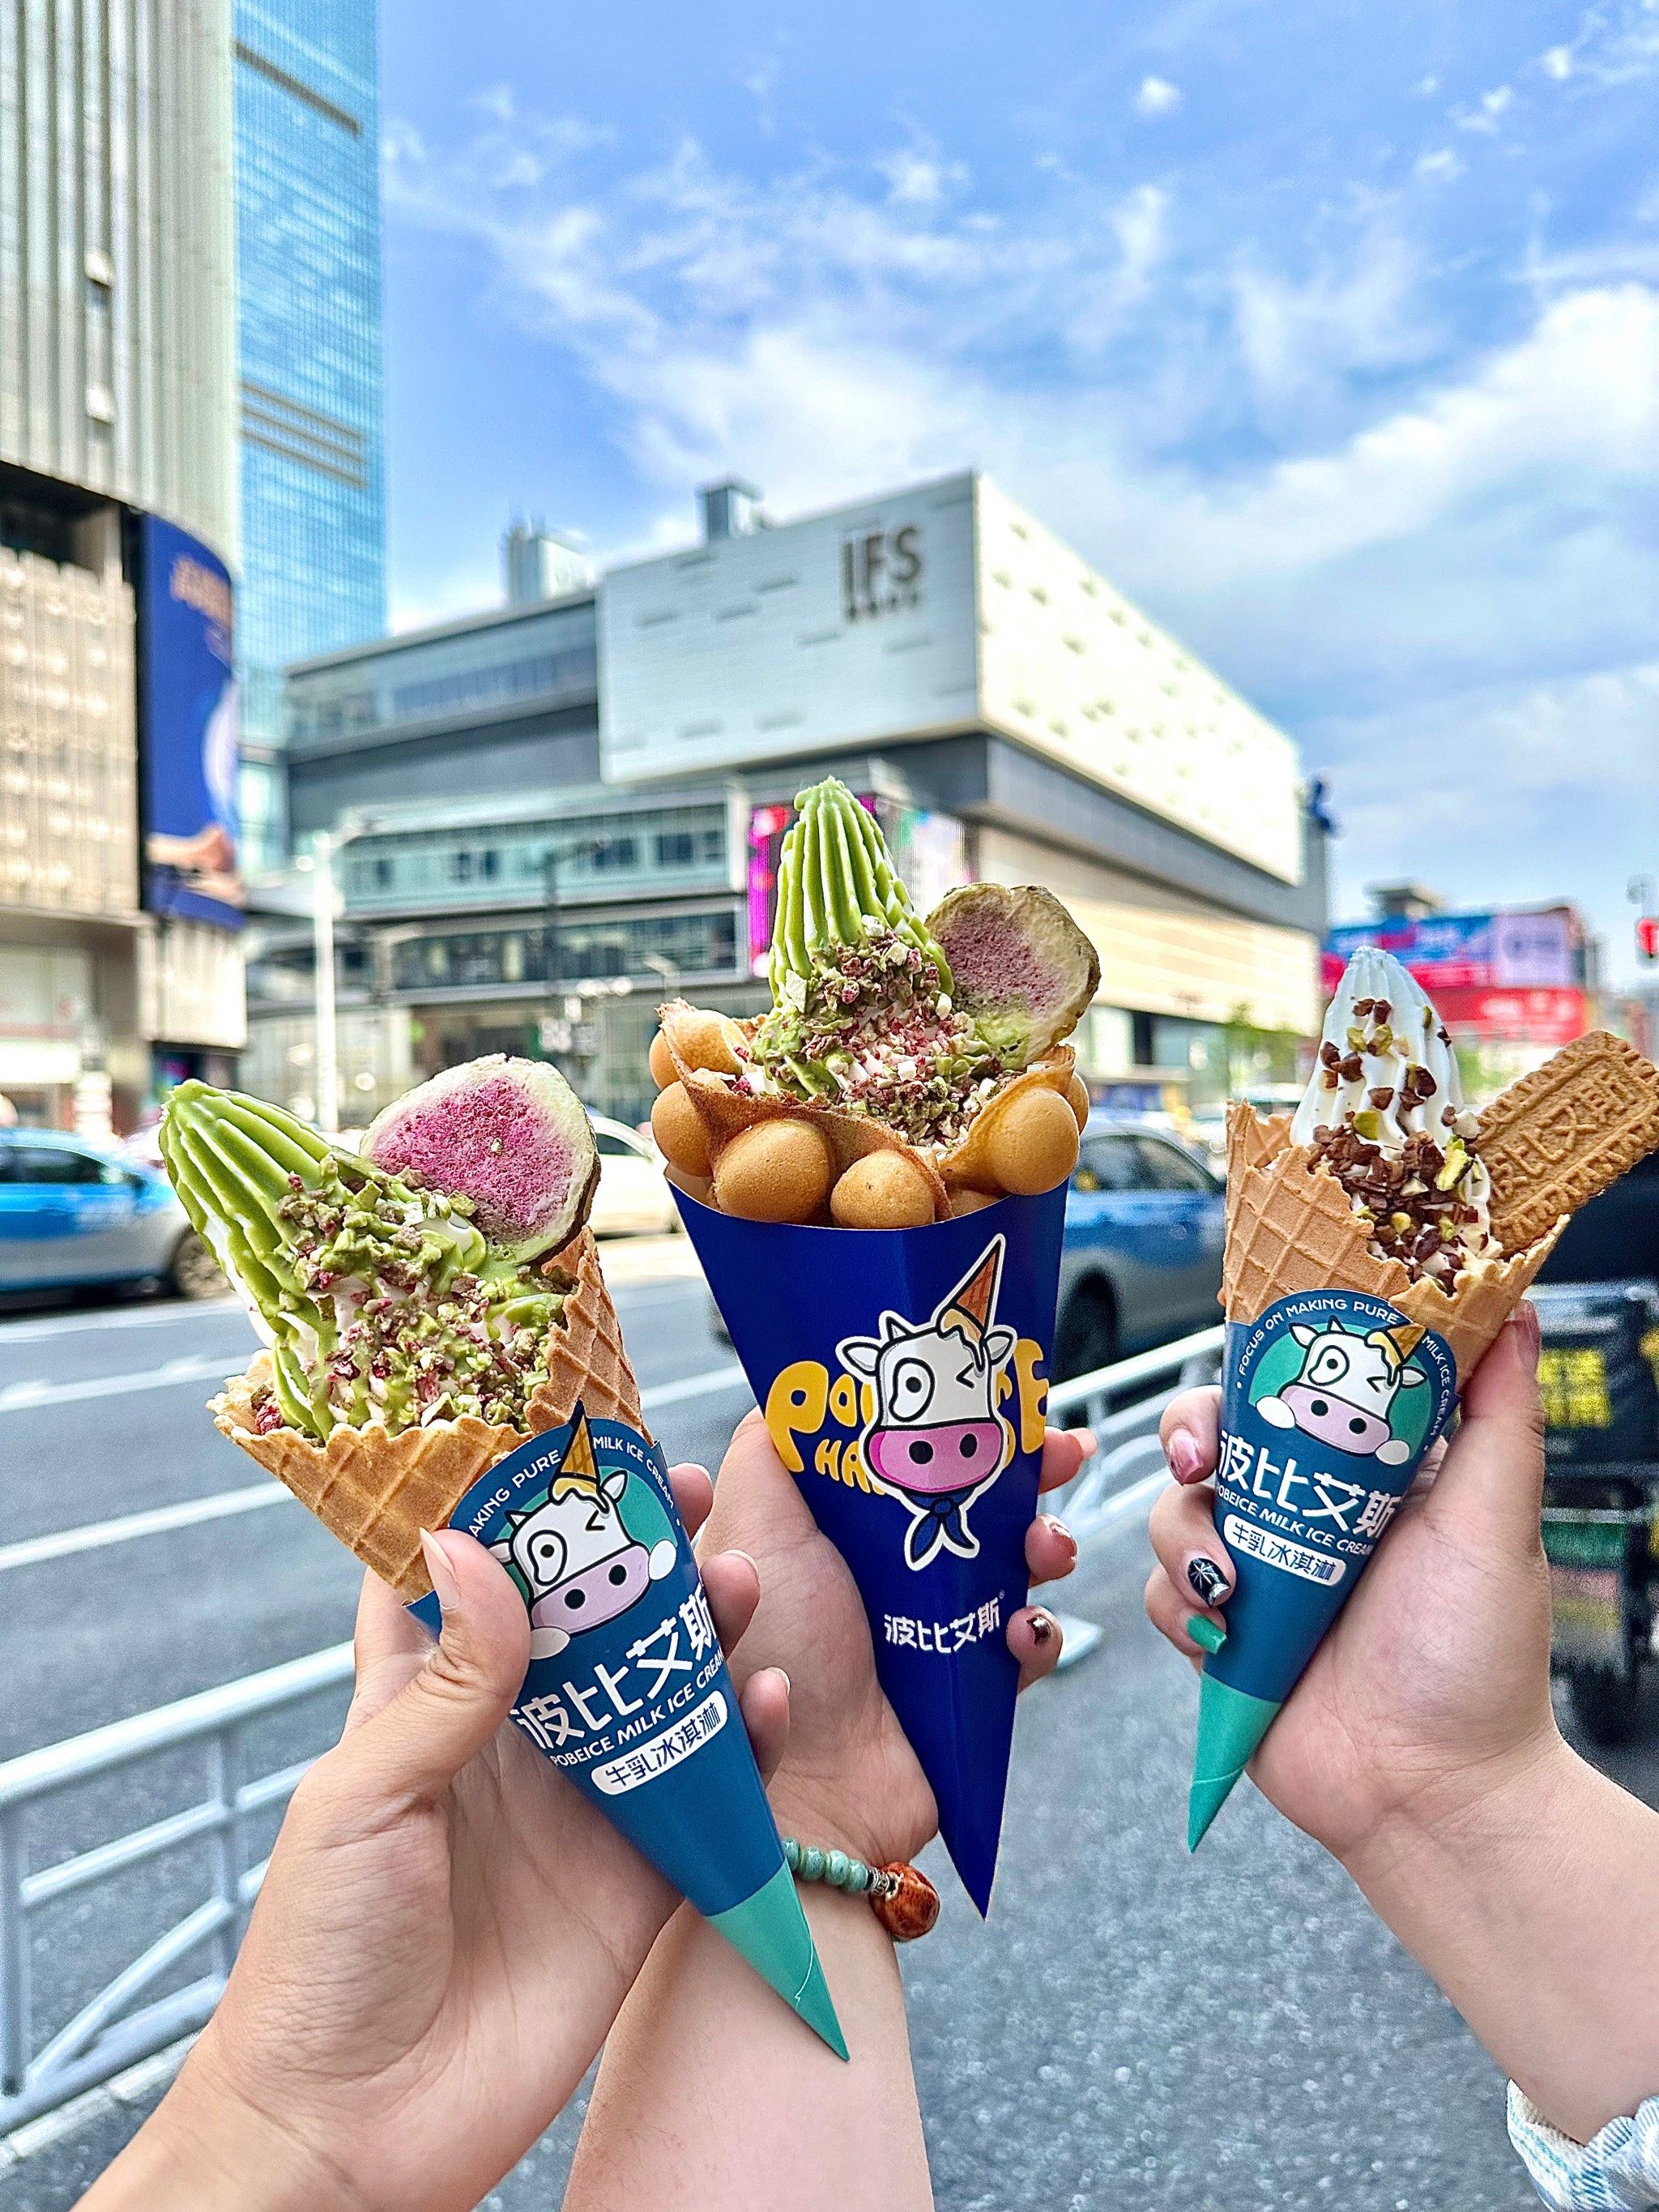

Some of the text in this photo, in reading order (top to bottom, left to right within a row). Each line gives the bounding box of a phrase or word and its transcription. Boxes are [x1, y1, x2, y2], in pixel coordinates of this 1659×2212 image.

[842, 525, 922, 604] IFS
[1239, 1299, 1450, 1436] FOCUS ON MAKING PURE MILK ICE CREAM
[468, 1436, 674, 1538] AKING PURE MILK ICE CREAM
[1218, 1430, 1402, 1539] 波比艾斯
[1231, 1520, 1337, 1581] 牛乳冰淇淋
[1259, 1507, 1307, 1537] MILK
[1305, 1527, 1336, 1548] ICE
[884, 1596, 1000, 1654] 波比艾斯
[510, 1584, 717, 1749] 波比艾斯
[605, 1702, 722, 1787] 牛乳冰淇淋
[616, 1704, 667, 1745] MILK
[667, 1682, 696, 1714] ICE
